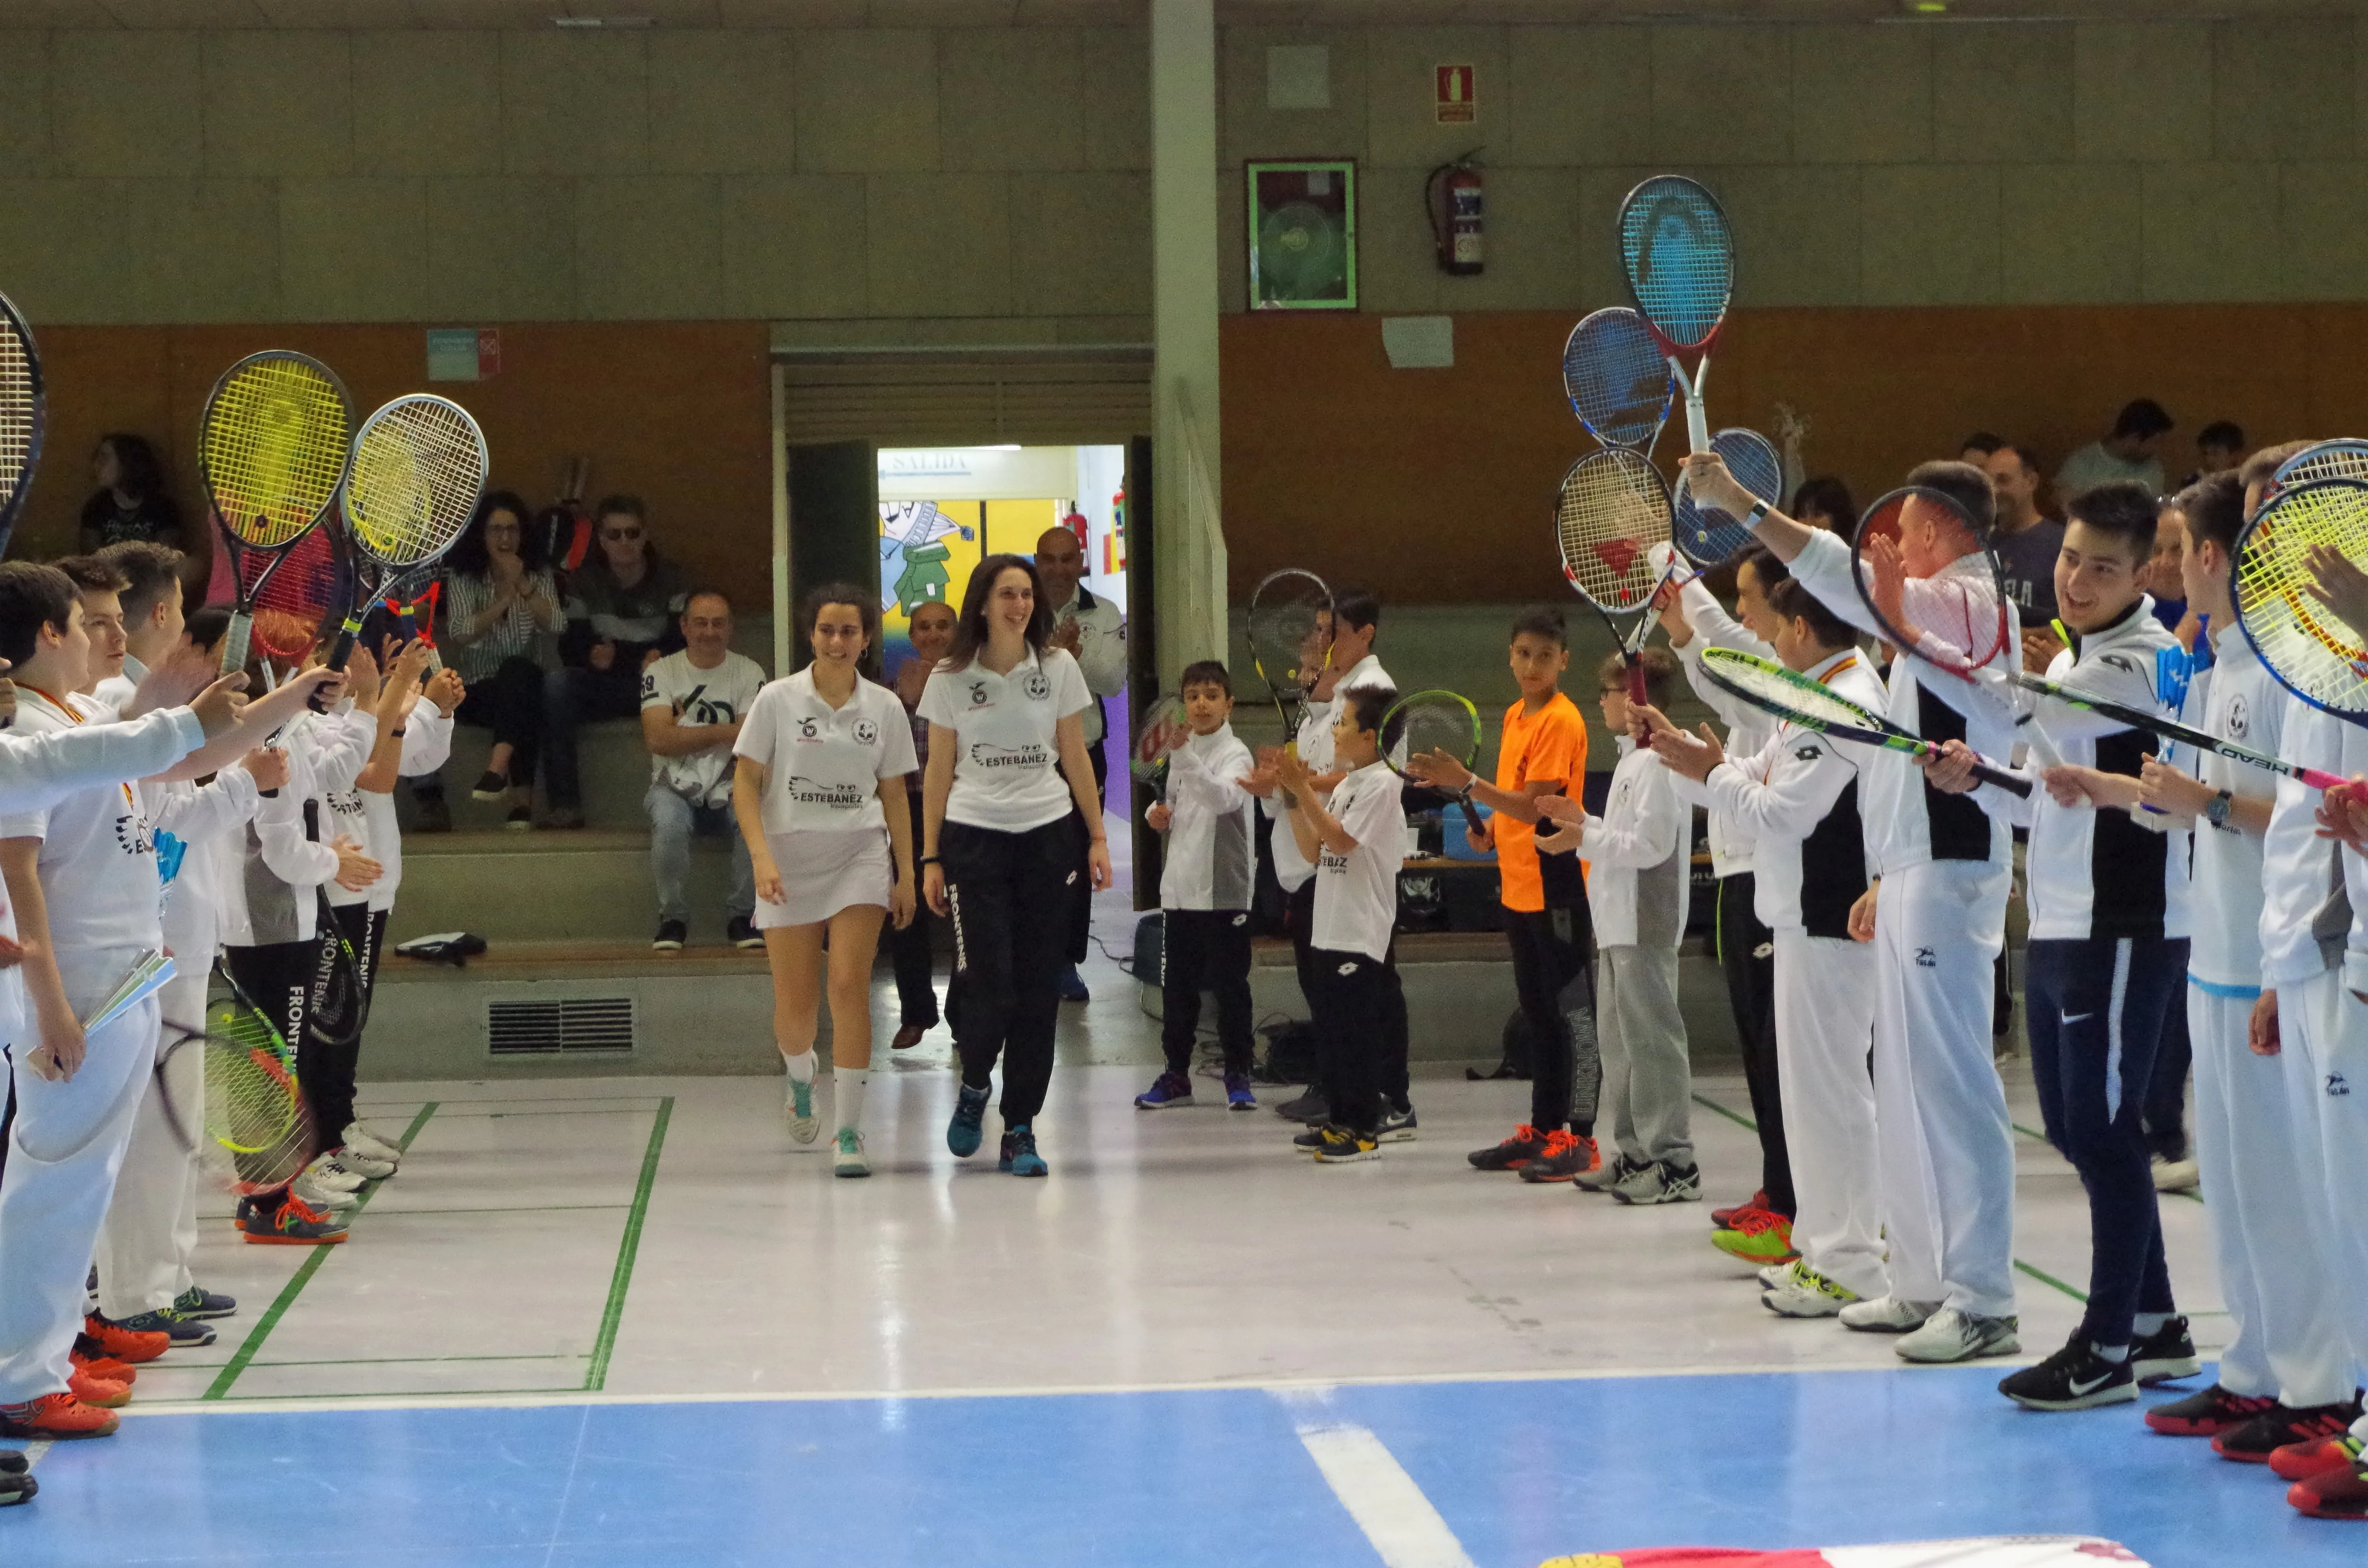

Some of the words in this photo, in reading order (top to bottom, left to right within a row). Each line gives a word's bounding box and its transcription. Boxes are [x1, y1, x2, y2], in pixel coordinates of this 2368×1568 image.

[892, 454, 965, 469] SALIDA
[986, 753, 1048, 768] ESTEBANEZ
[2221, 748, 2289, 775] HEAD
[801, 793, 863, 803] ESTEBANEZ
[949, 883, 968, 972] FRONTENIS
